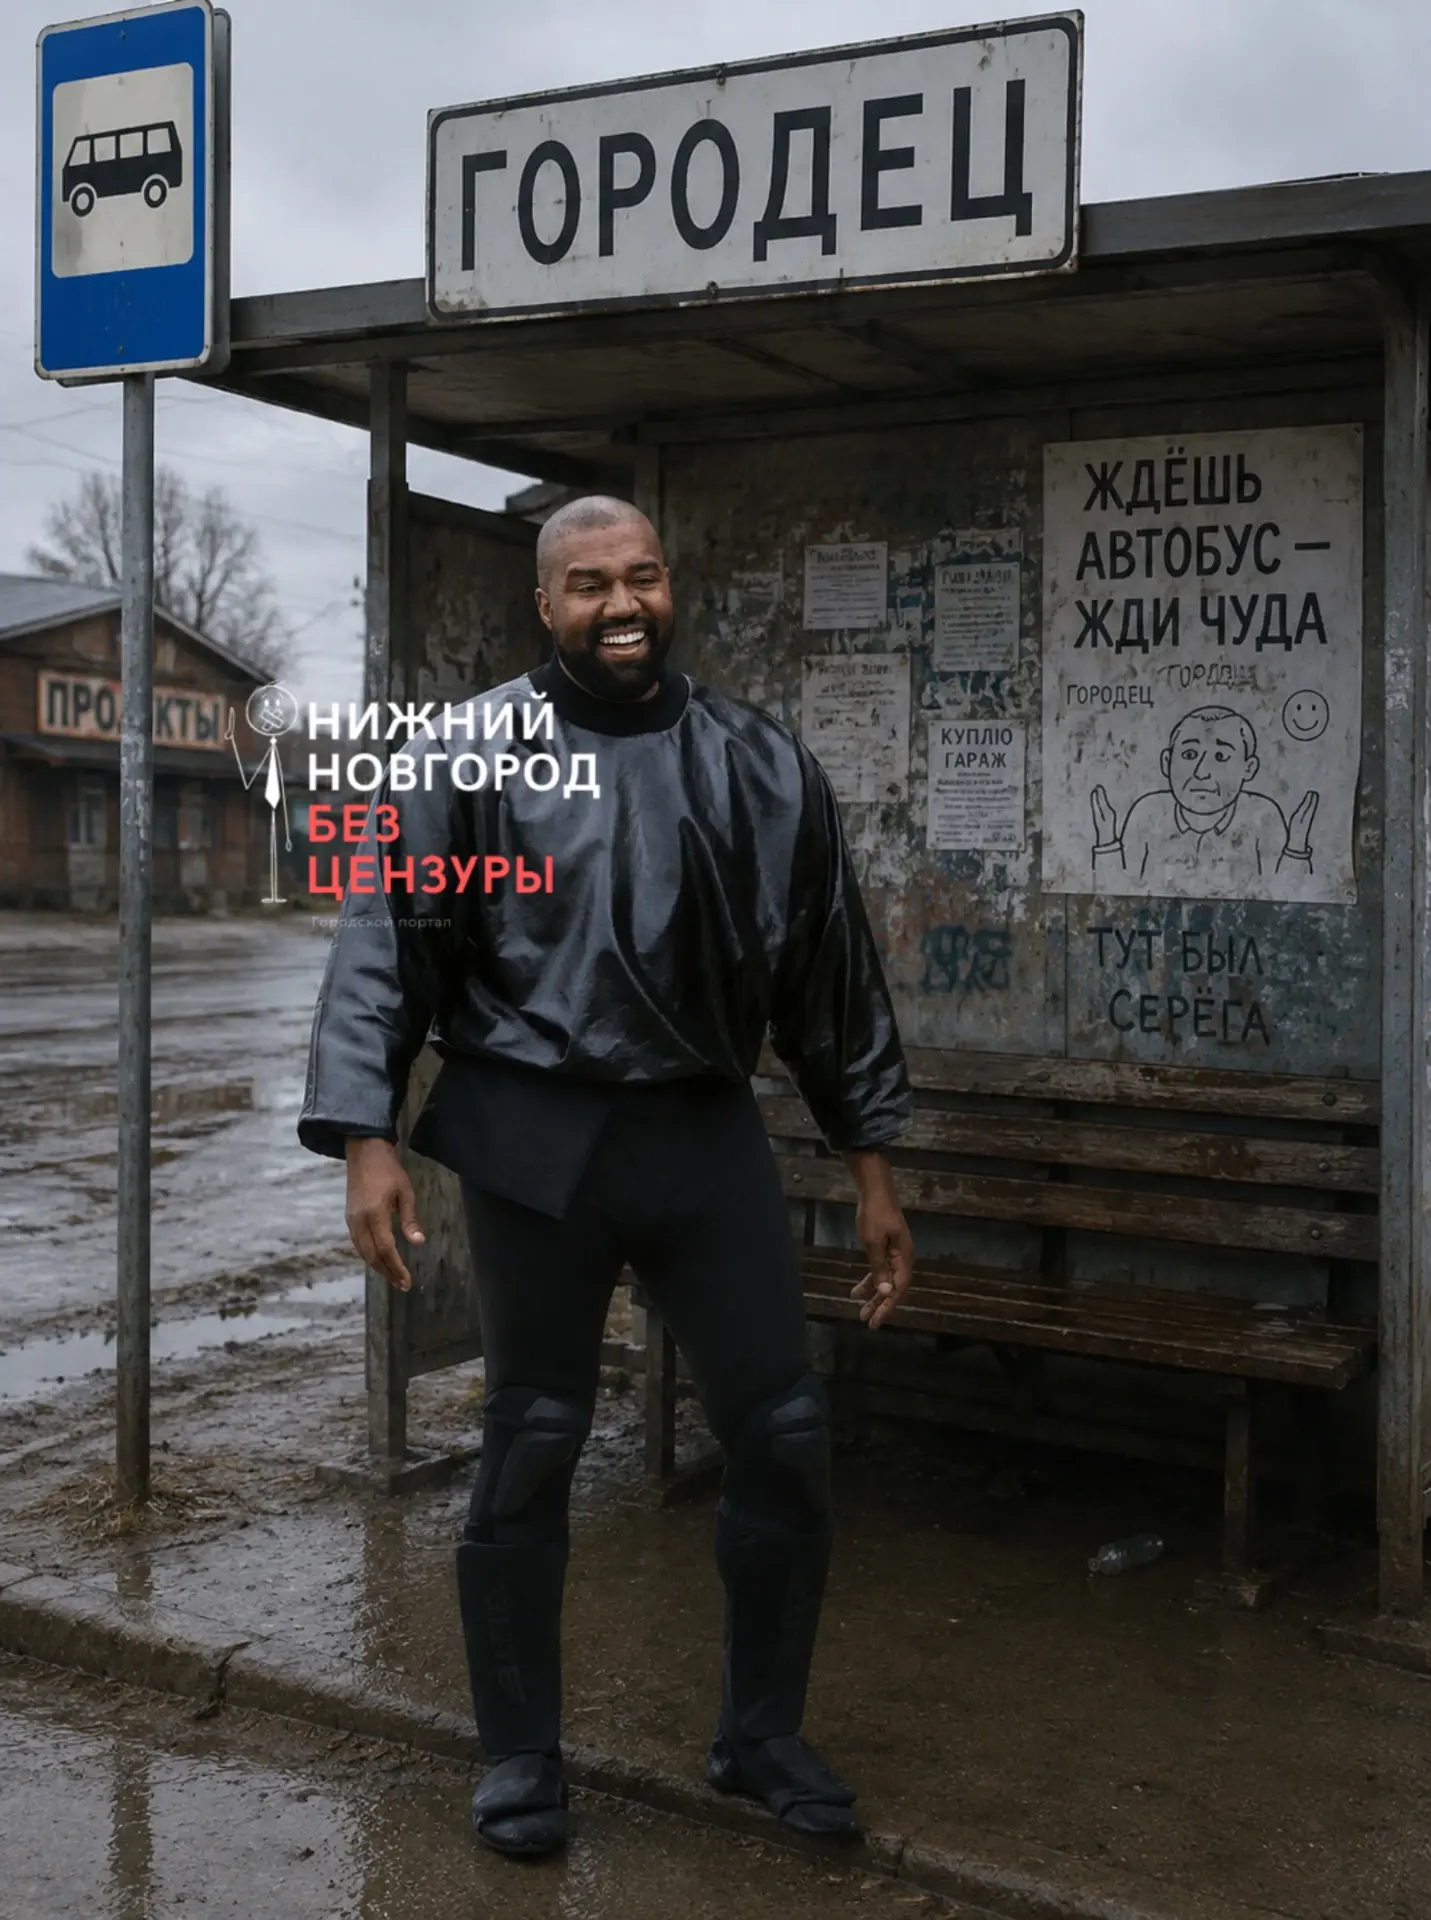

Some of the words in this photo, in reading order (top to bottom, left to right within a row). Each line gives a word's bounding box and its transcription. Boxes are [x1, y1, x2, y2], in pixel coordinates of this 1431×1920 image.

[461, 78, 1032, 272] ГОРОДЕЦ
[1084, 447, 1262, 515] ЖДЁШЬ
[1076, 522, 1281, 580] АВТОБУС
[1074, 597, 1181, 653] ЖДИ
[1200, 592, 1327, 651] ЧУДА
[49, 681, 220, 740] ПРОКТЫ
[1067, 684, 1153, 708] ГОРОДЕЦ
[940, 727, 1013, 746] КУПЛЮ
[945, 752, 1007, 769] ГАРАЖ
[1087, 926, 1161, 970] ТУТ
[1181, 930, 1264, 976] БЫЛ
[1108, 986, 1270, 1046] СЕРЁГА
